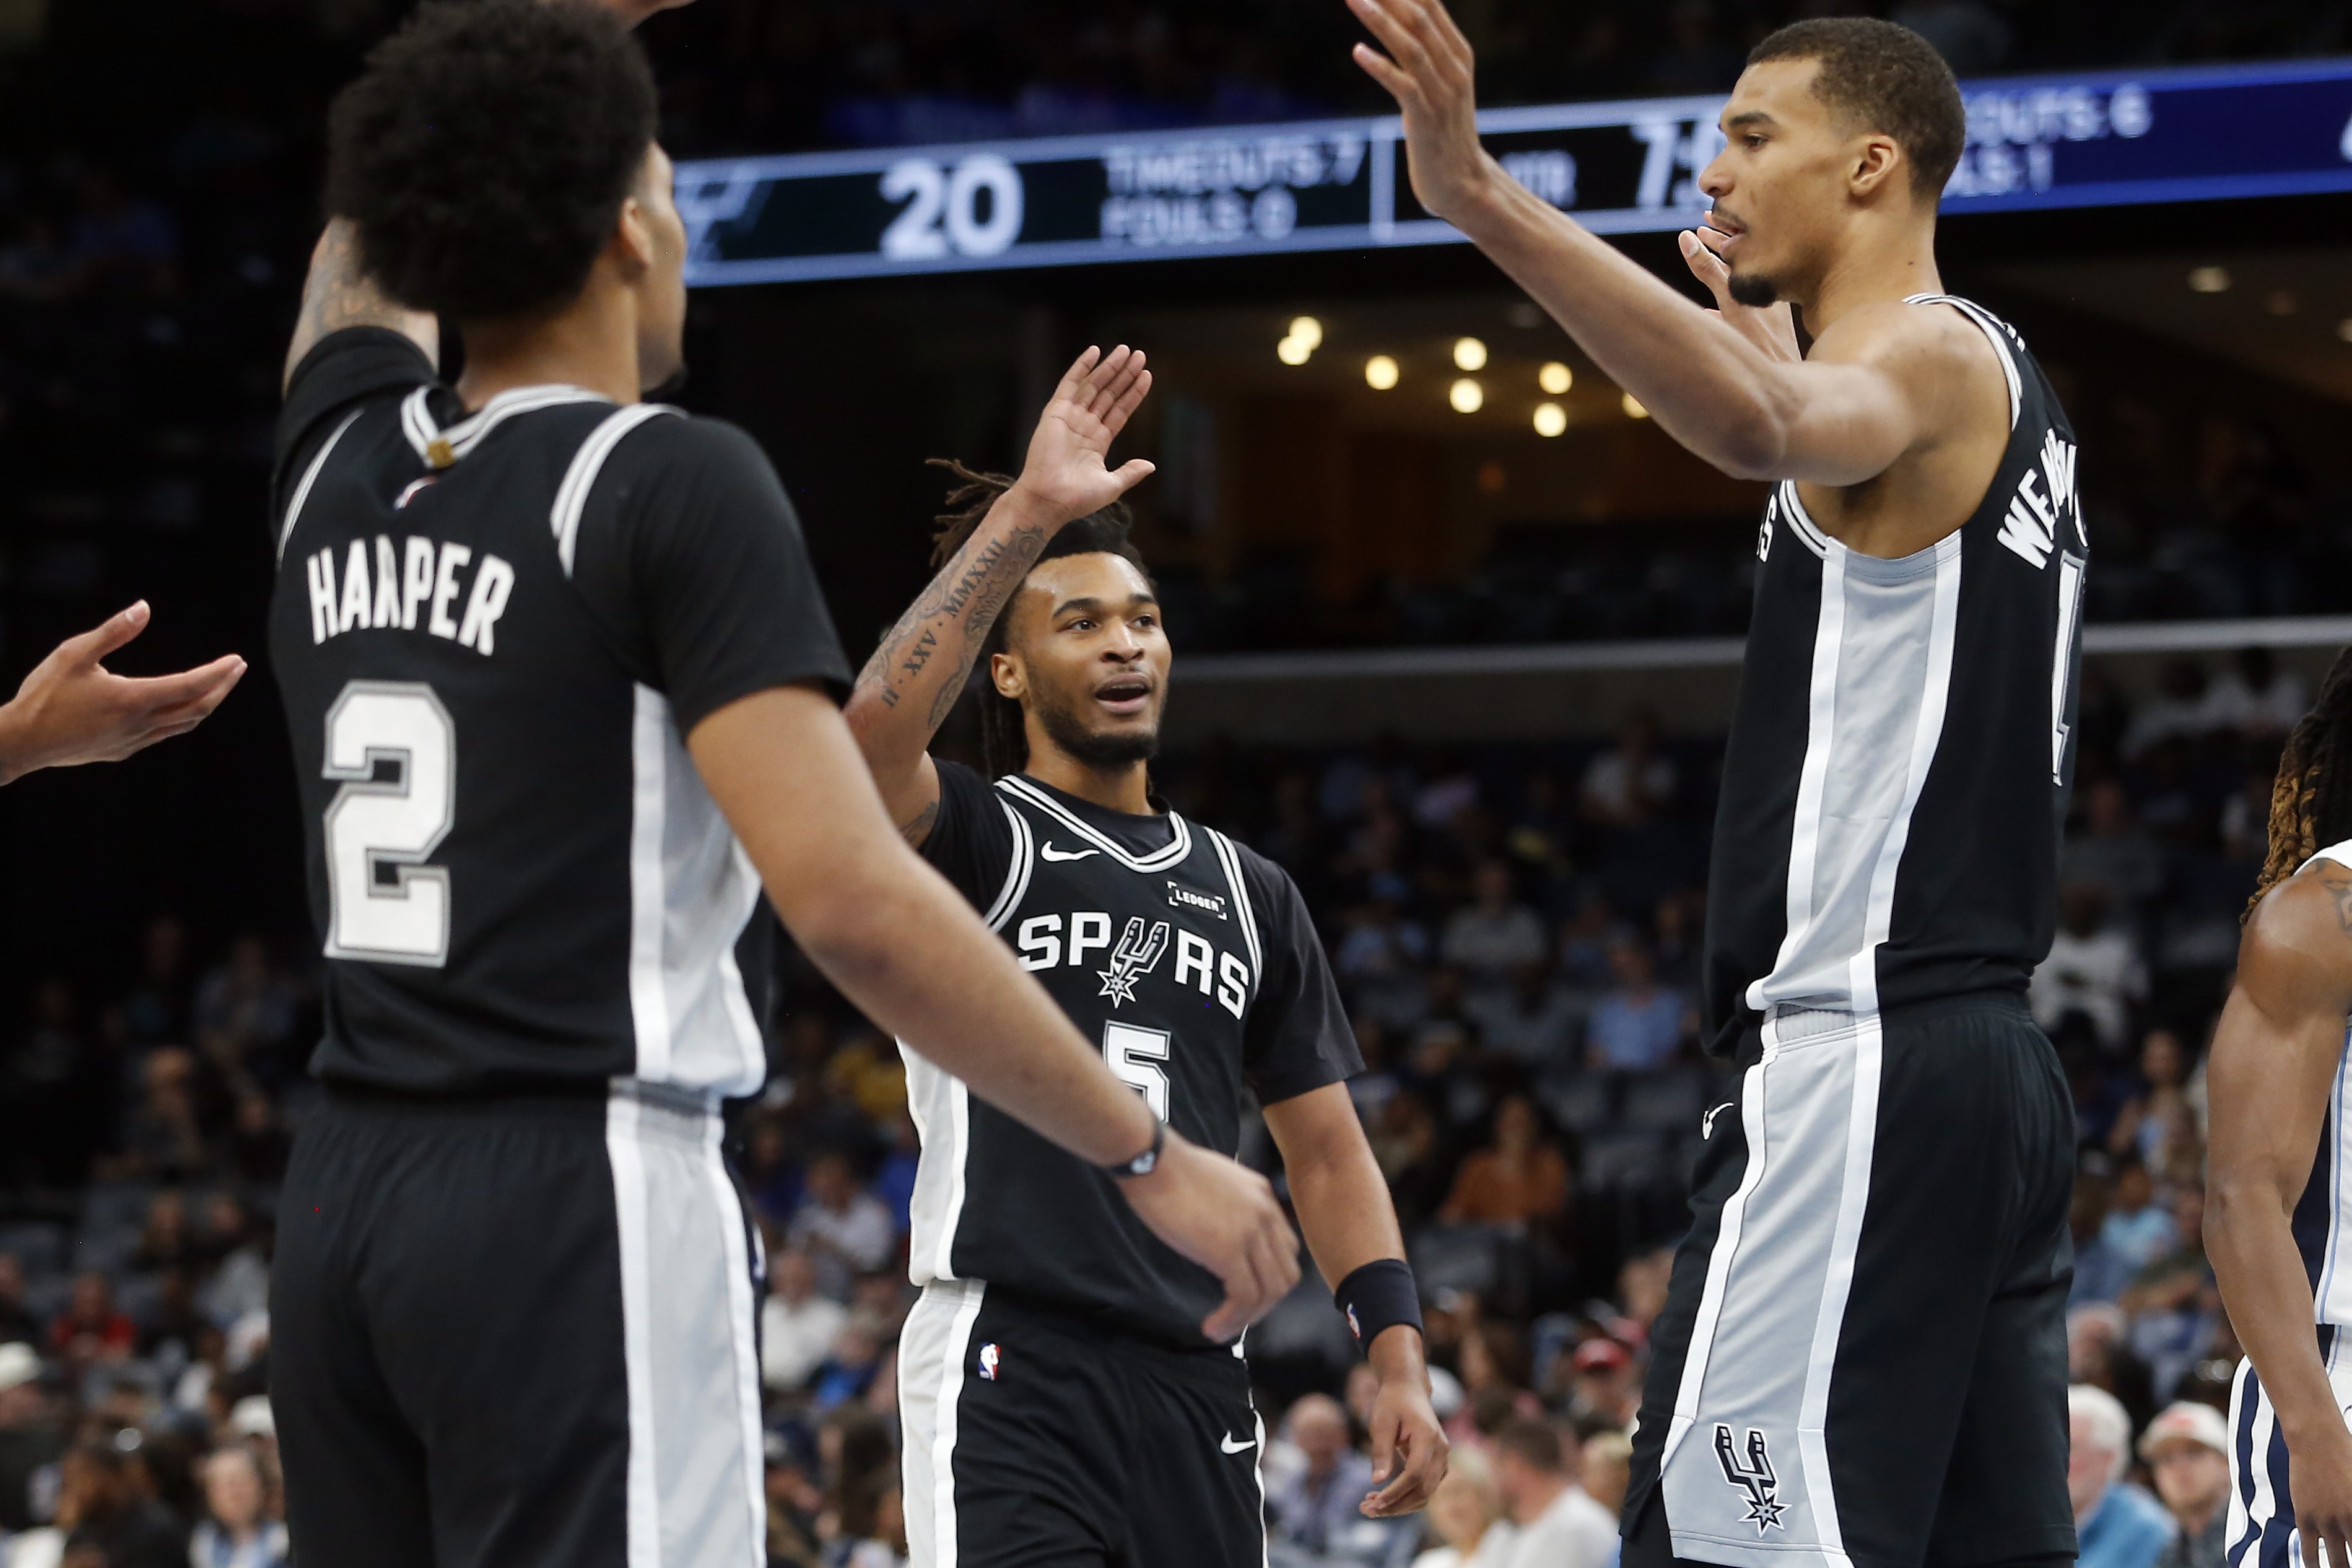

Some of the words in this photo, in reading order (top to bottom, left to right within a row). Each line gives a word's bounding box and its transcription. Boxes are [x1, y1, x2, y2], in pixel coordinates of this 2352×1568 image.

[878, 154, 1026, 261] 20
[307, 534, 515, 656] HARPER
[902, 628, 937, 677] XXV
[322, 680, 457, 968] 2
[1175, 889, 1220, 913] LEDGER
[1017, 911, 1250, 1021] SPURS
[1102, 1019, 1172, 1124] 5
